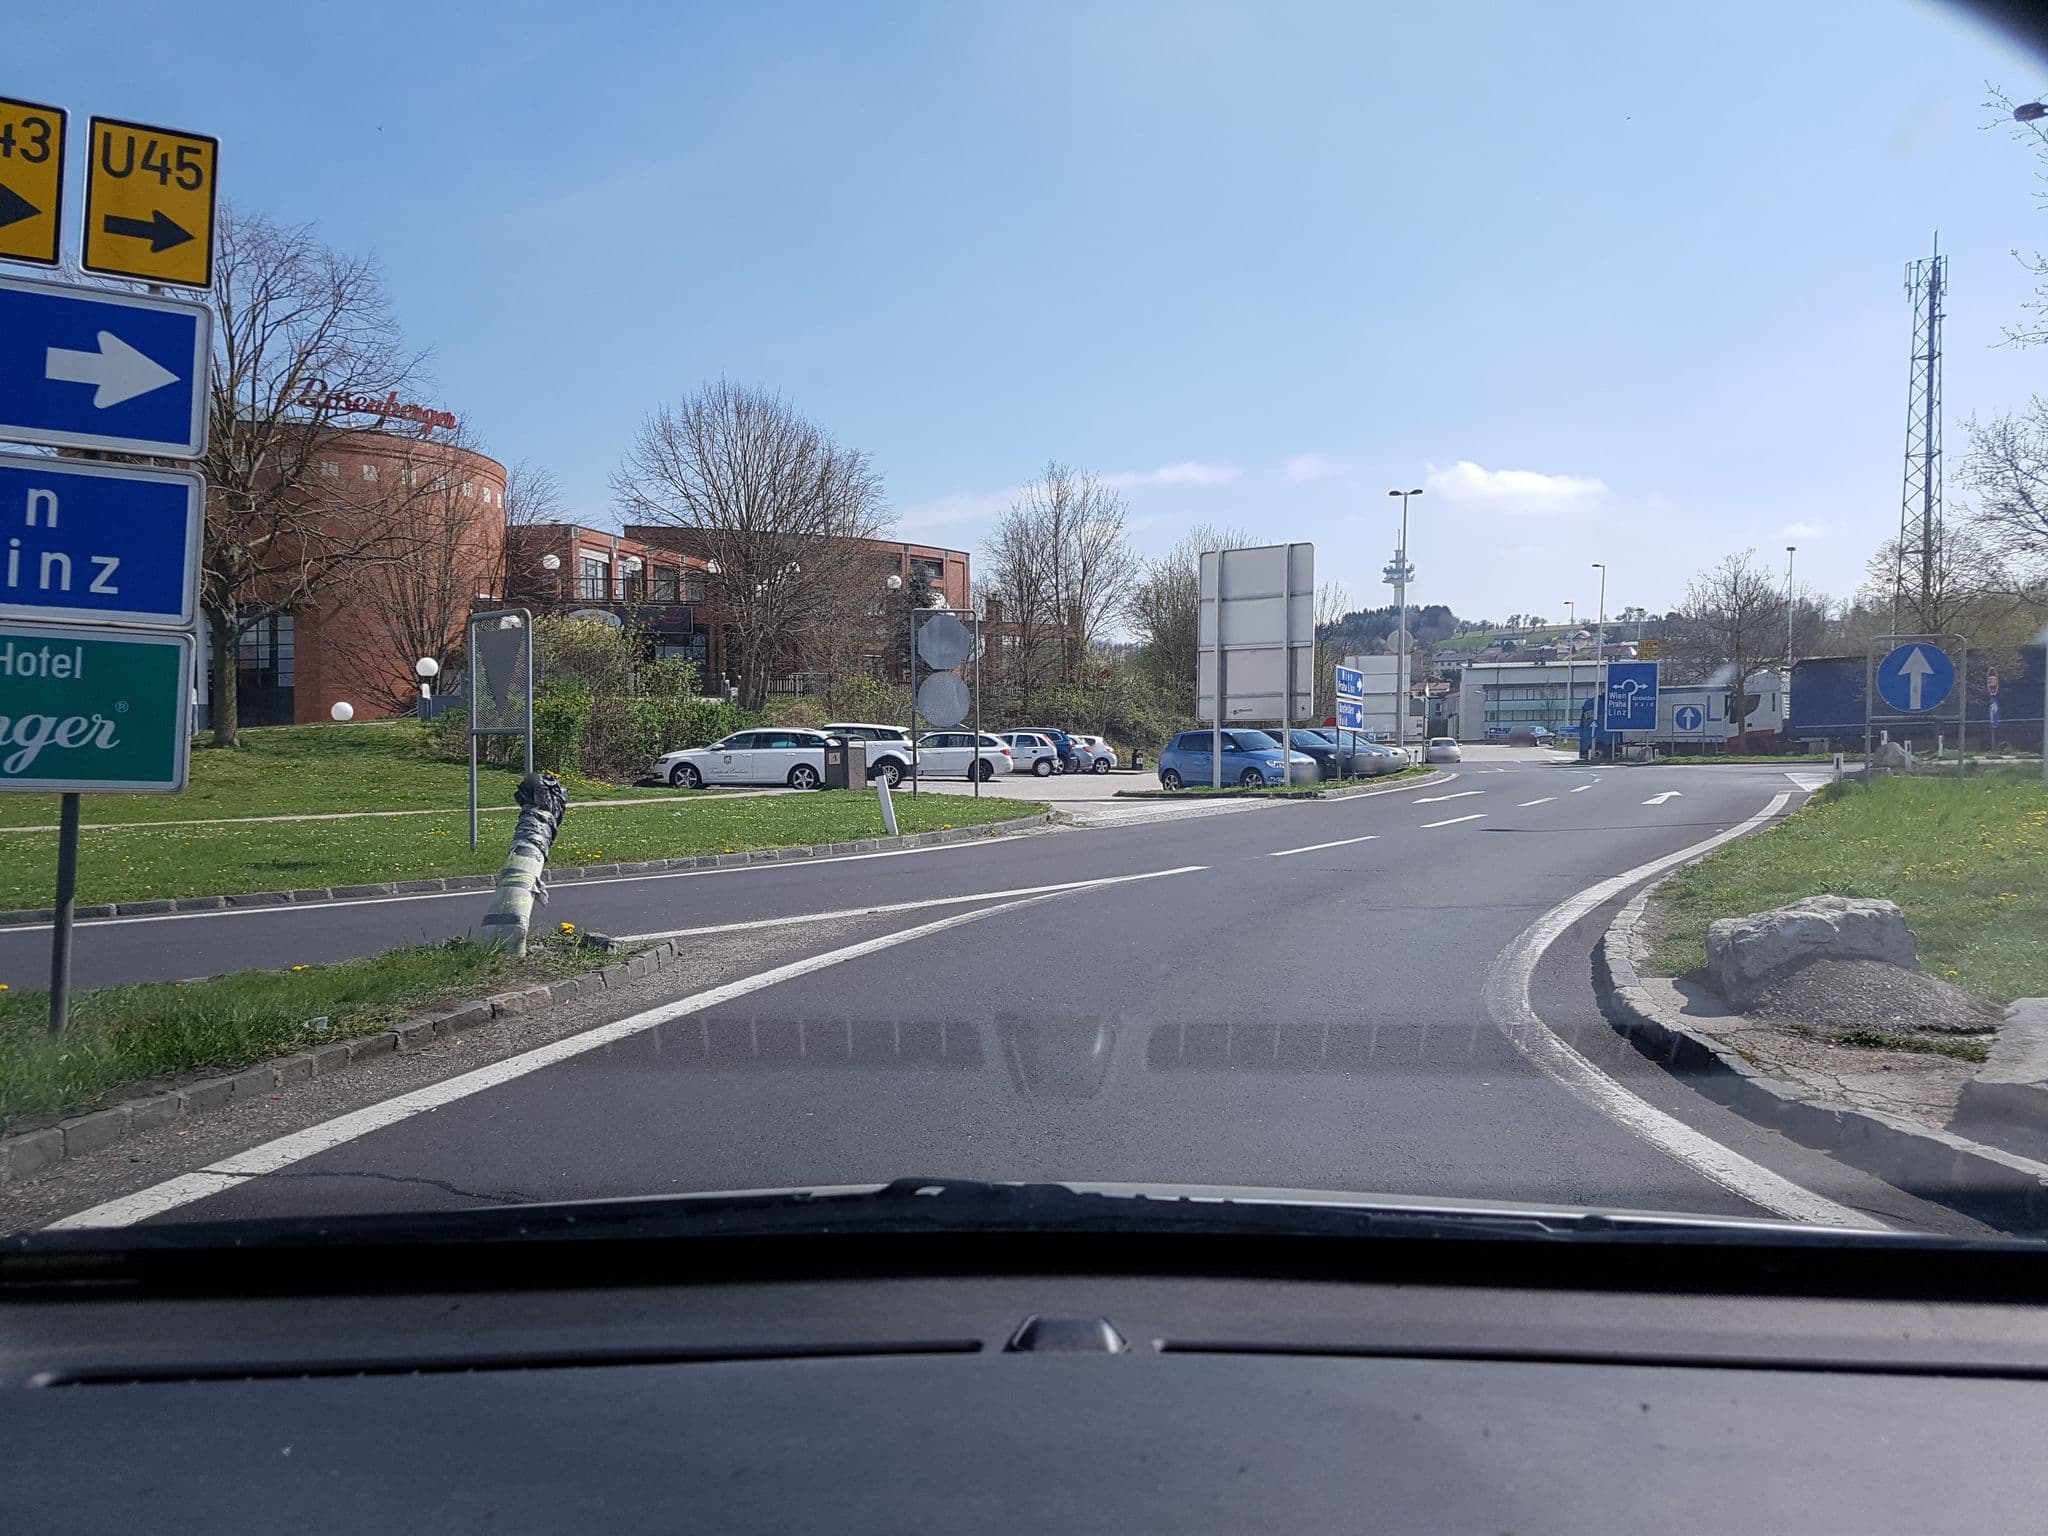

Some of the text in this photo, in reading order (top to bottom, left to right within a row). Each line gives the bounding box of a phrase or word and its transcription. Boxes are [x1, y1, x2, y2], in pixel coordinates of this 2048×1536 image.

[102, 131, 203, 190] U45
[7, 538, 121, 595] inz
[0, 642, 83, 679] Hotel
[1608, 691, 1627, 700] Wien
[1608, 700, 1627, 708] Praha
[1608, 708, 1627, 717] Linz
